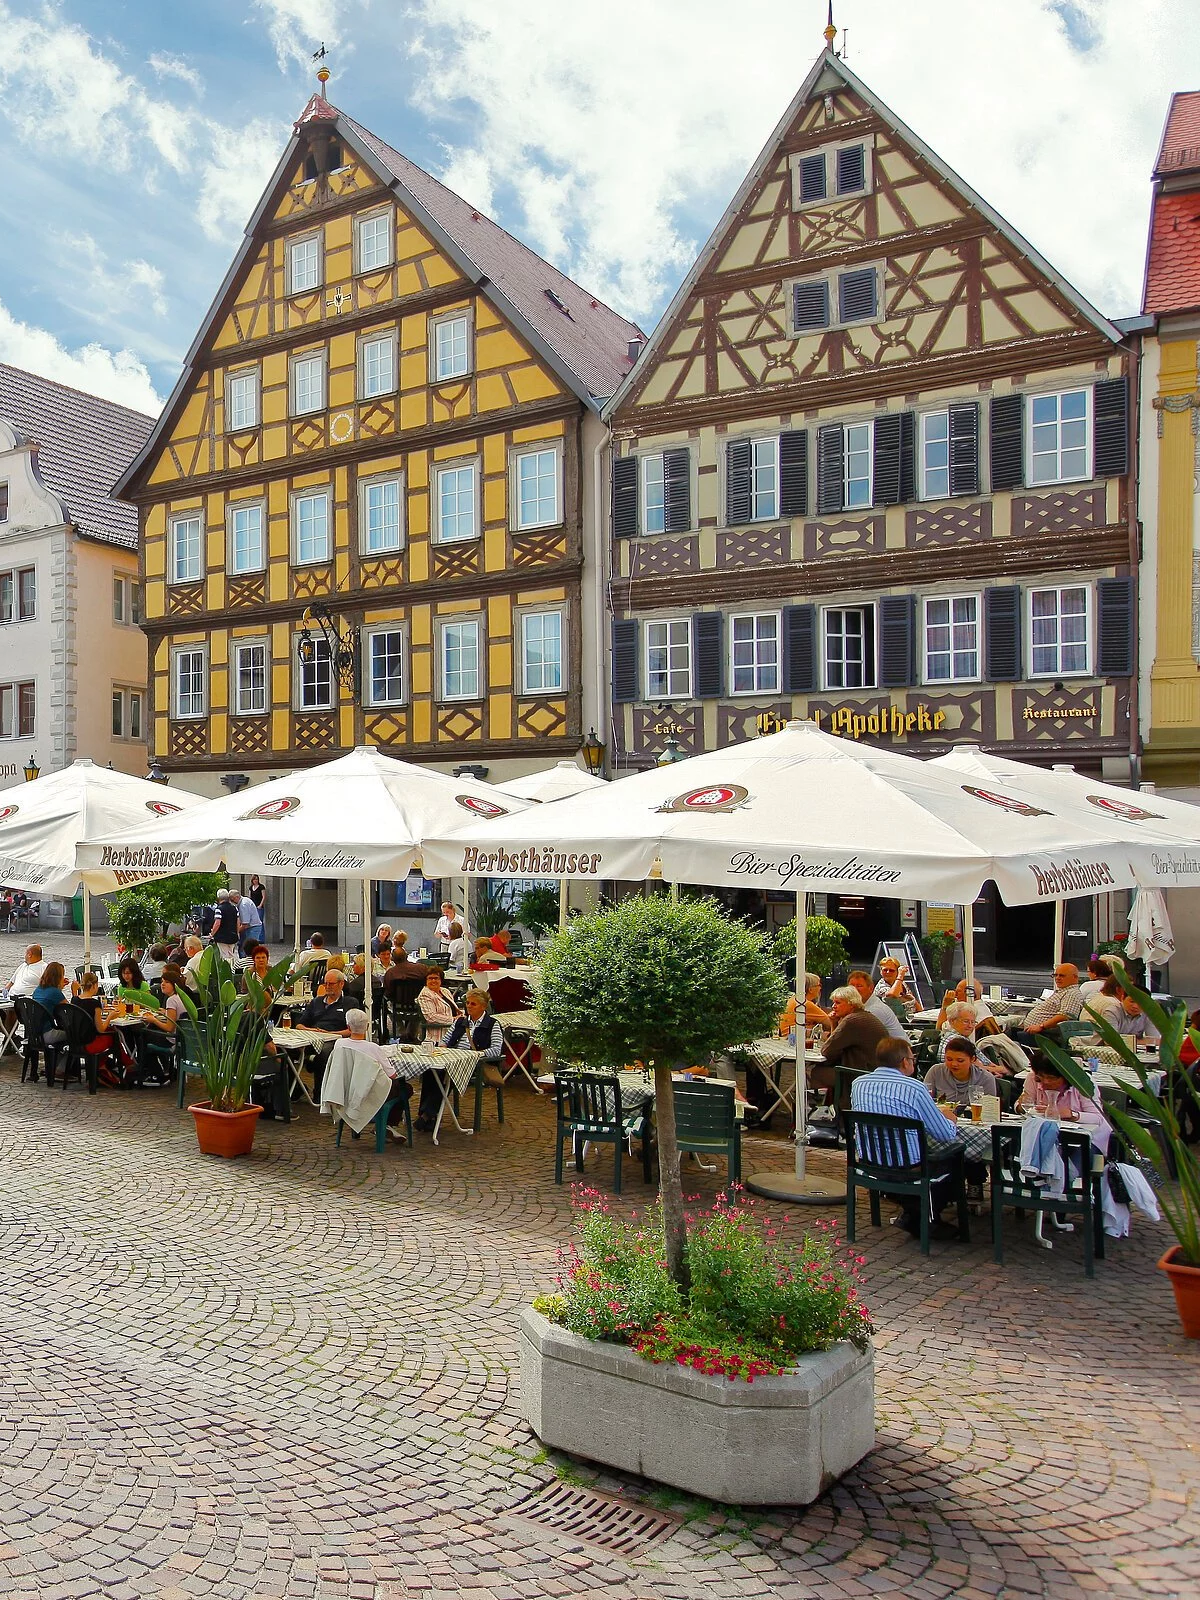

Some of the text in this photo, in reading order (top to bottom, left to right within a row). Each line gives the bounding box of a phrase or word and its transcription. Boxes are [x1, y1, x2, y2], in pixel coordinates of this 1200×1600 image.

[755, 704, 947, 739] Enl Apotheke
[1022, 706, 1098, 720] Restaurant
[99, 846, 190, 867] Herbsthäuser
[264, 848, 366, 875] Bier-Spezialitäten
[460, 846, 602, 874] Herbsthäuser
[726, 851, 902, 887] Bier-Spezialitäten
[1027, 858, 1115, 896] Herbsthäuser
